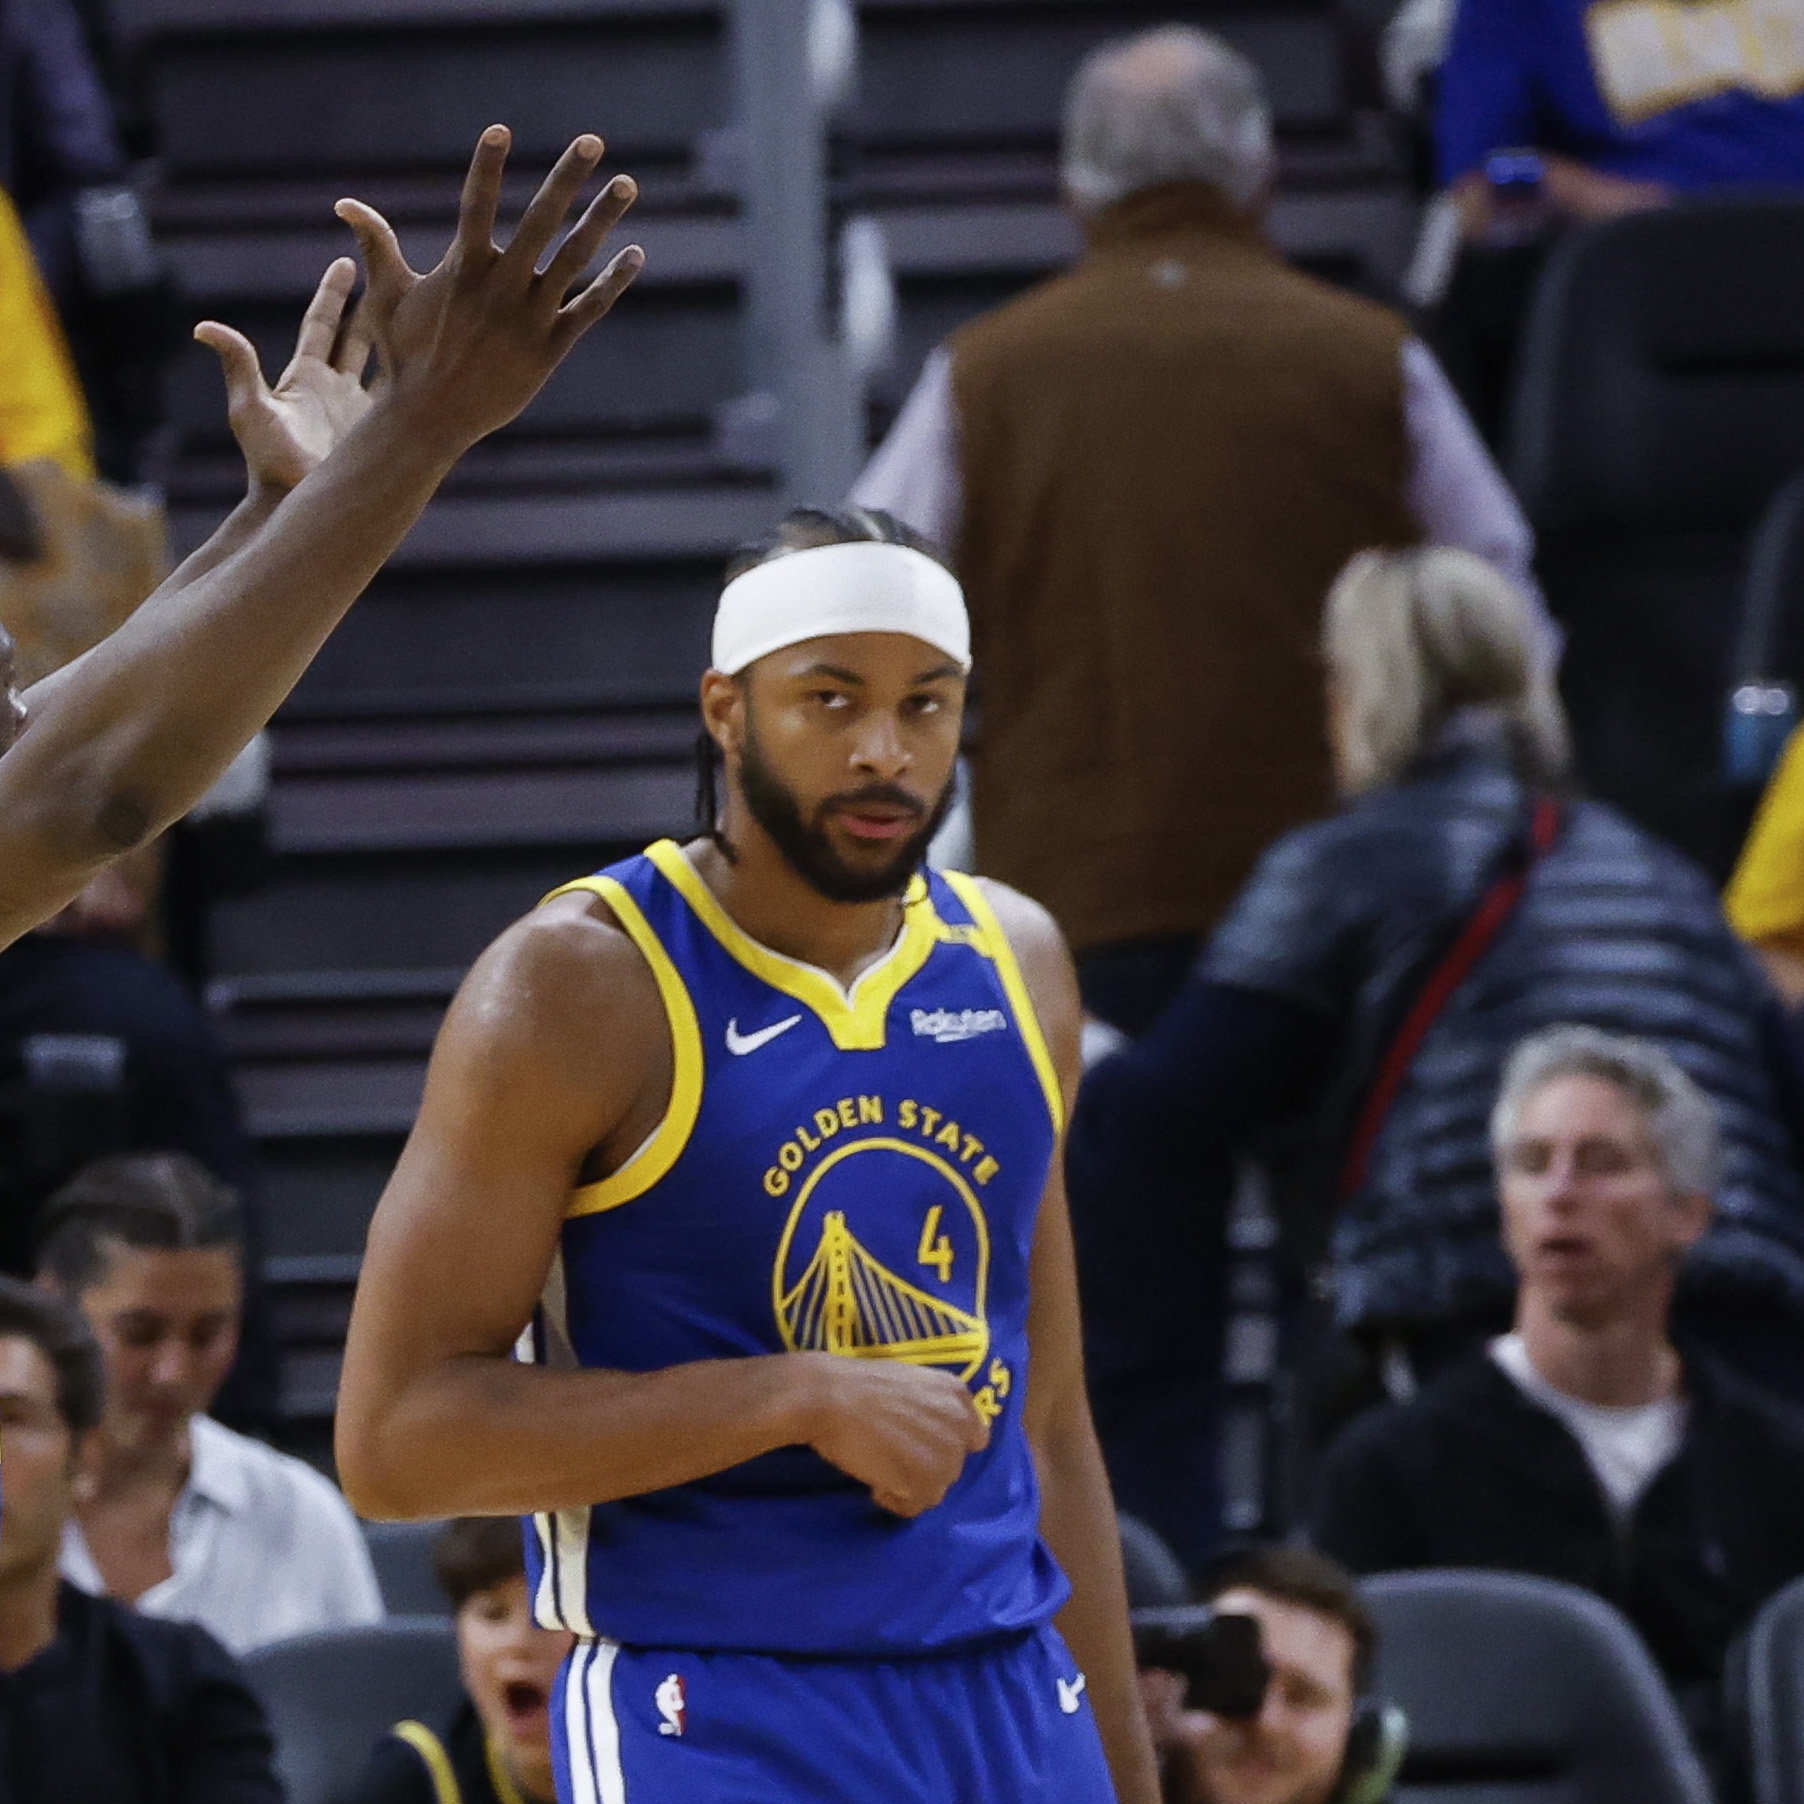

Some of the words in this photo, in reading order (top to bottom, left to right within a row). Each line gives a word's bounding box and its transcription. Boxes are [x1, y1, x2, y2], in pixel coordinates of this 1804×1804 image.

[763, 1094, 884, 1198] GOLDEN
[898, 1099, 1001, 1186] STATE
[917, 1205, 954, 1284] 4
